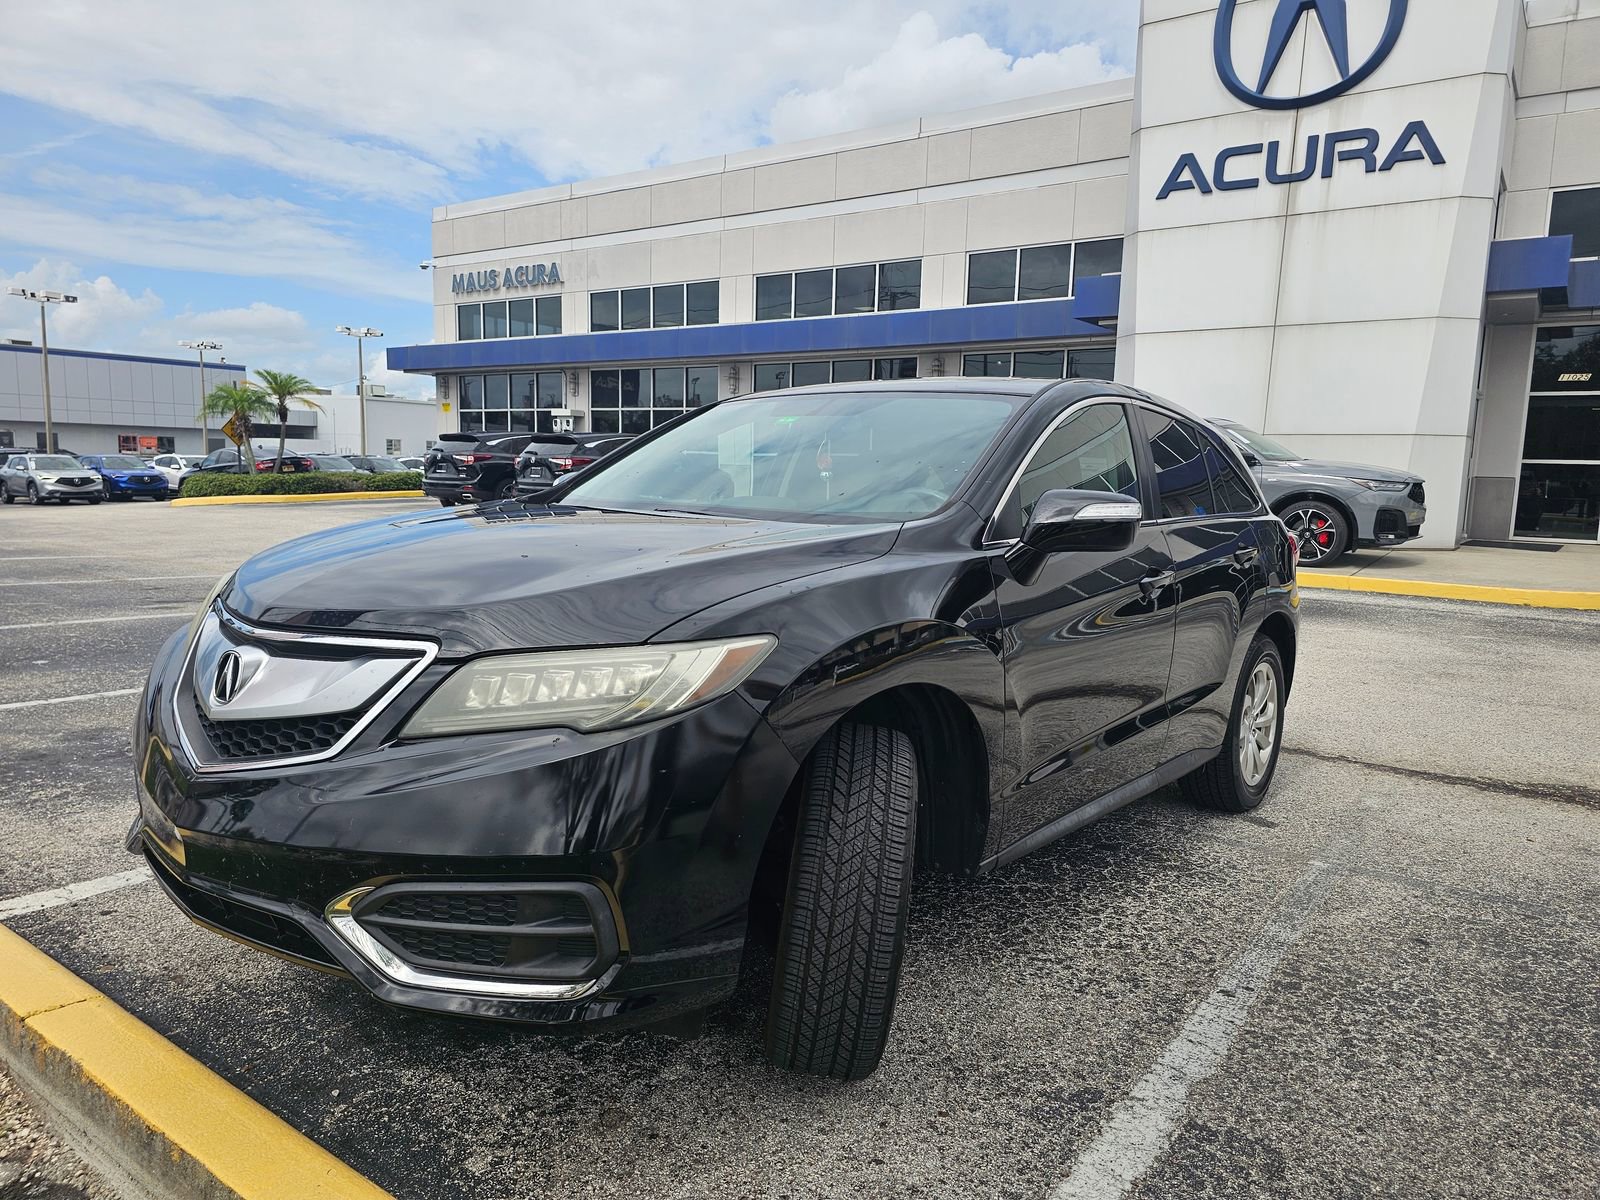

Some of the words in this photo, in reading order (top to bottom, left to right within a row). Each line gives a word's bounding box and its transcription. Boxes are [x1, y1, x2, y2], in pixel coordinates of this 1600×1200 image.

[1155, 120, 1446, 201] ACURA
[452, 269, 499, 294] MAUS
[502, 262, 563, 289] ACURA
[1560, 373, 1590, 381] 11025
